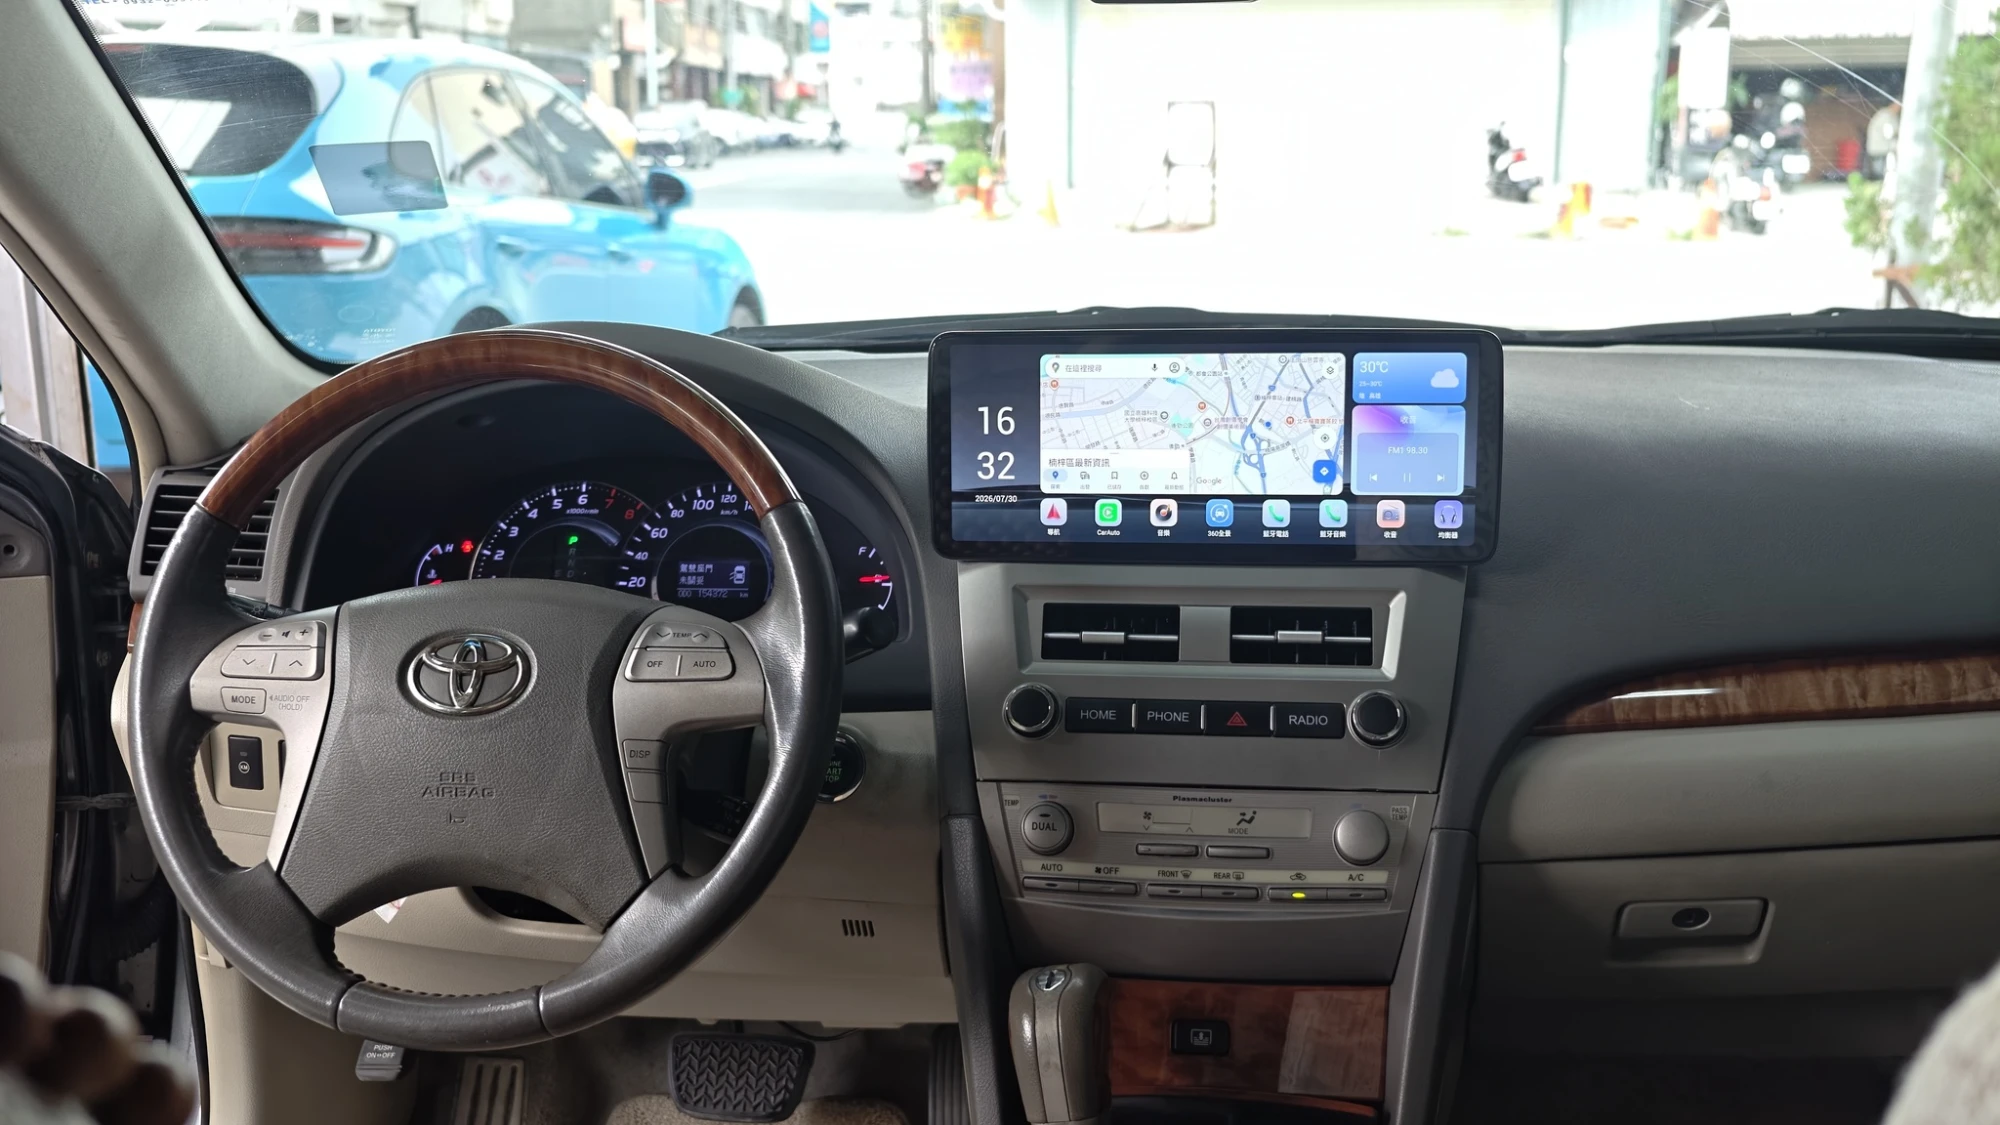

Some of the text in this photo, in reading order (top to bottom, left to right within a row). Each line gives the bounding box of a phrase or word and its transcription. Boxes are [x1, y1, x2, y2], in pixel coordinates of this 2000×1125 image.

[1065, 364, 1102, 373] 在這裡搜尋
[977, 406, 1015, 435] 16
[1400, 416, 1416, 424] 收音
[977, 451, 1015, 480] 32
[1048, 458, 1110, 468] 楠梓區最新資訊
[1196, 476, 1221, 485] Google
[577, 494, 588, 505] 6
[720, 494, 737, 503] 120
[975, 495, 1017, 503] 2026/07/30
[552, 499, 563, 509] 5
[605, 499, 614, 508] 7
[692, 500, 714, 510] 100
[527, 508, 538, 519] 4
[624, 509, 635, 519] 8
[670, 510, 684, 518] 80
[508, 526, 519, 537] 3
[650, 528, 668, 538] 60
[1383, 531, 1397, 539] 收音
[1437, 531, 1459, 539] 均衡器
[568, 536, 578, 545] P
[445, 543, 454, 552] H
[858, 546, 867, 555] F
[494, 550, 505, 560] 2
[634, 552, 648, 560] 40
[627, 576, 646, 587] 20
[698, 590, 728, 598] 154372
[647, 660, 663, 668] OFF
[693, 660, 716, 668] AUTO
[231, 695, 256, 704] MODE
[274, 695, 311, 703] AUDIO OFF
[278, 703, 303, 712] (HOLD)
[1080, 709, 1117, 720] HOME
[1146, 711, 1190, 722] PHONE
[1288, 715, 1328, 726] RADIO
[629, 750, 650, 758] DISP
[421, 786, 495, 798] AIRBAG
[1004, 798, 1020, 806] TEMP
[1172, 795, 1233, 803] Plasmacluster
[1391, 813, 1408, 821] TEMP
[1031, 821, 1058, 831] DUAL
[1040, 863, 1063, 872] AUTO
[1103, 866, 1120, 875] OFF
[1157, 870, 1179, 878] FRONT
[1213, 872, 1231, 880] REAR
[1348, 873, 1364, 882] A/C
